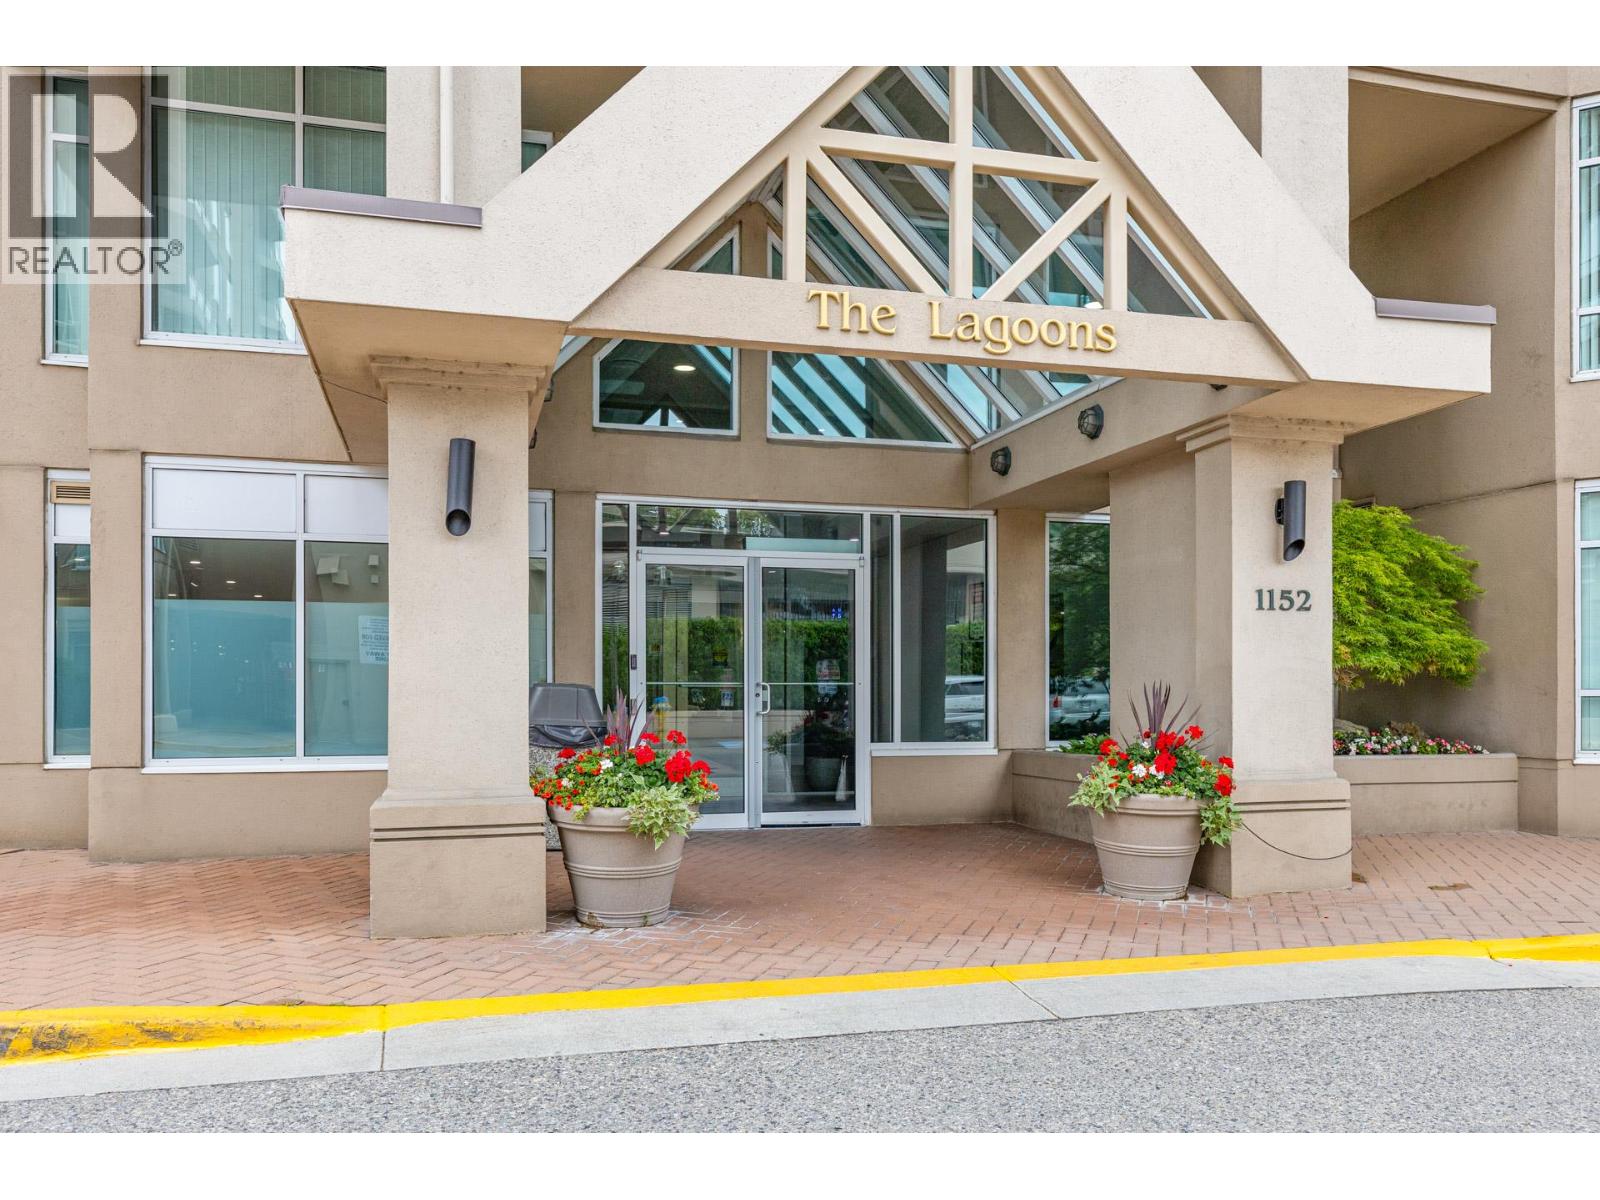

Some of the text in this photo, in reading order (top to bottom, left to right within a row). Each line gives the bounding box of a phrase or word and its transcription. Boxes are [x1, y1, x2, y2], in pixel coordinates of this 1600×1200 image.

[808, 289, 1118, 354] The Lagoons
[1255, 588, 1312, 612] 1152
